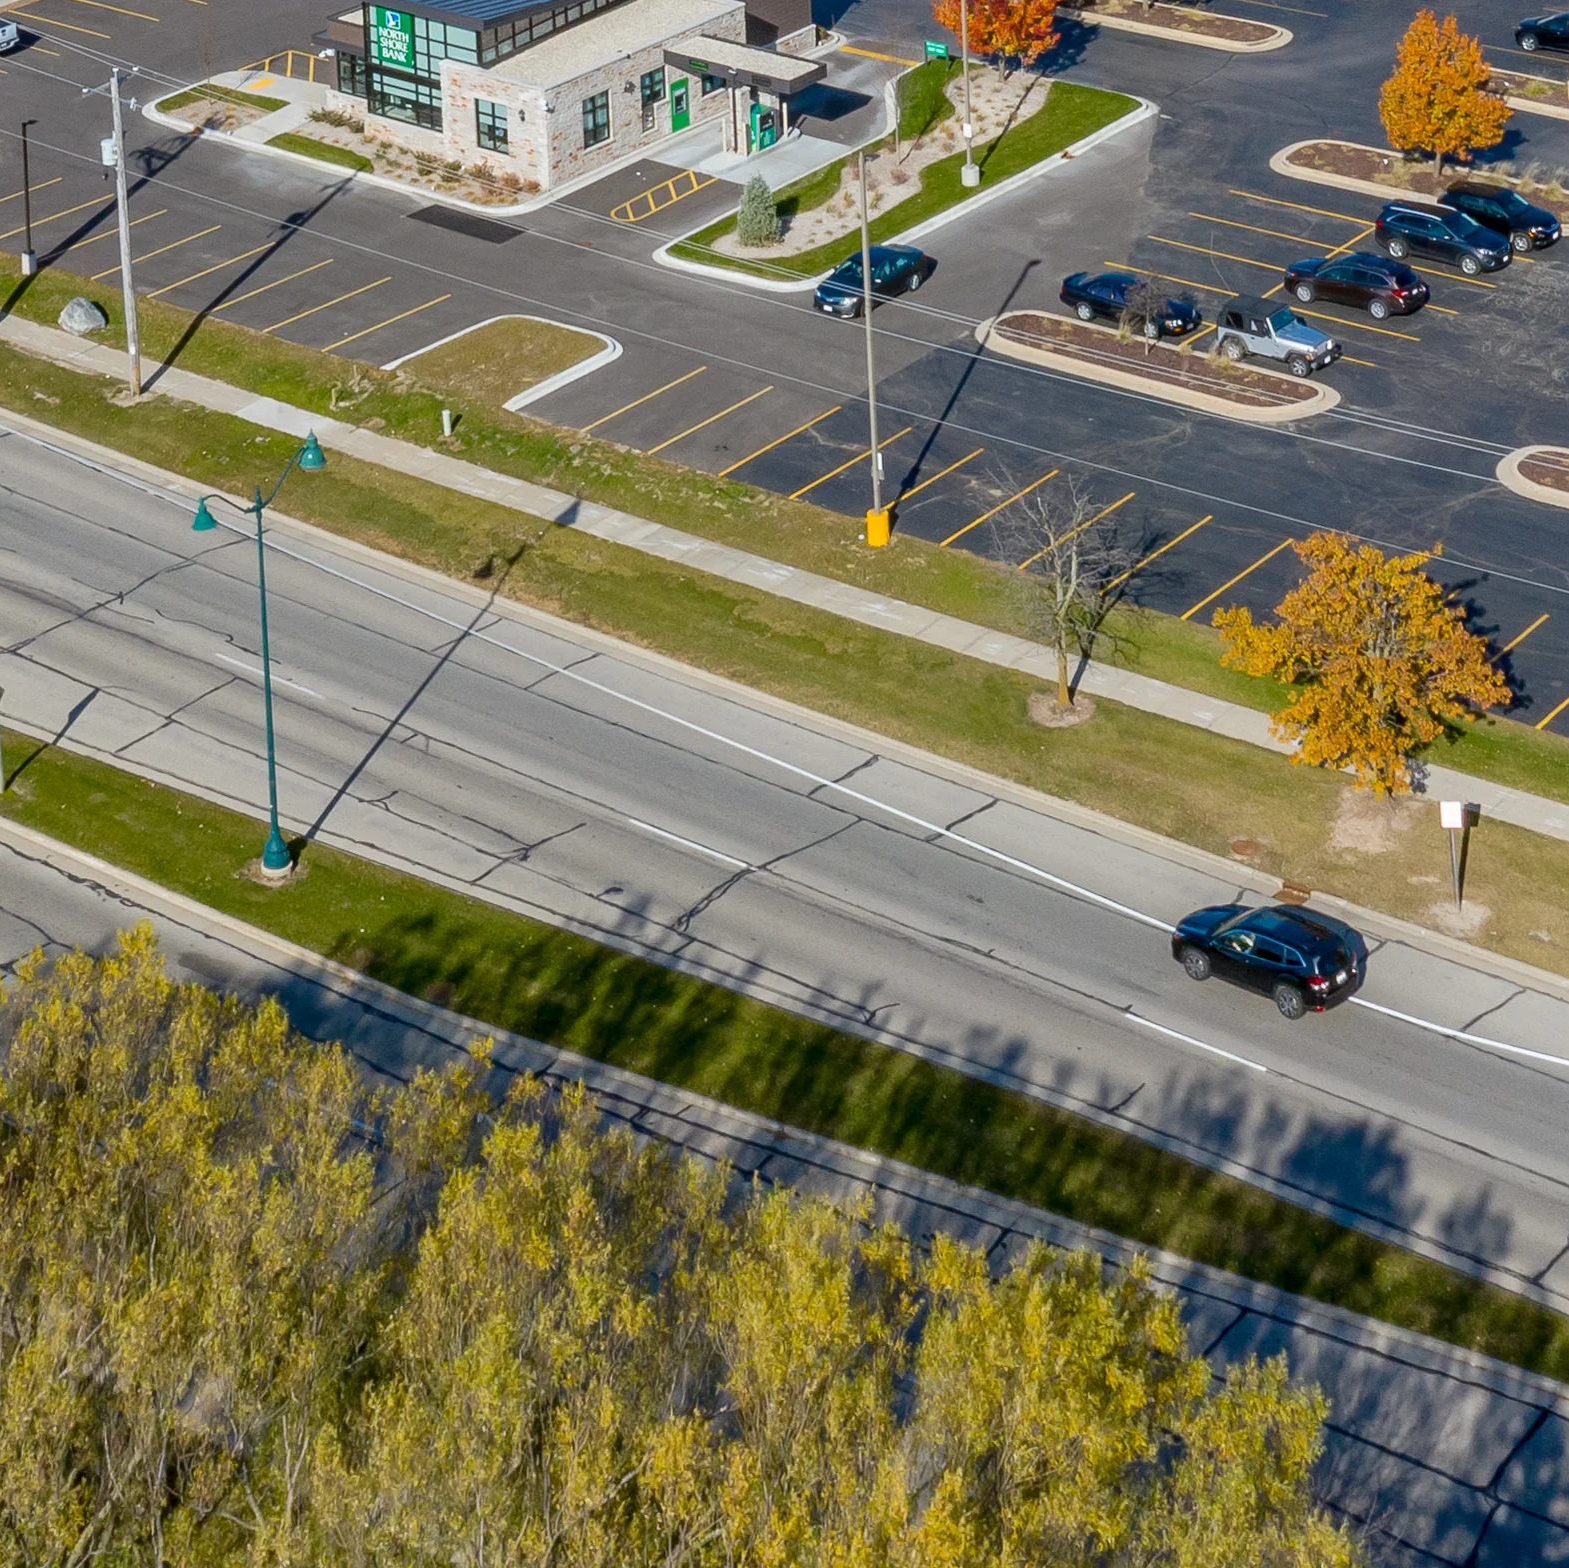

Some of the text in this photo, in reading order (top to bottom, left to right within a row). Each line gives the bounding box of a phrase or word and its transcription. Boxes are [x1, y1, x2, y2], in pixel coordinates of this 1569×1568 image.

[378, 26, 409, 43] NORTH
[380, 36, 409, 53] SHORE
[382, 47, 407, 63] BANK
